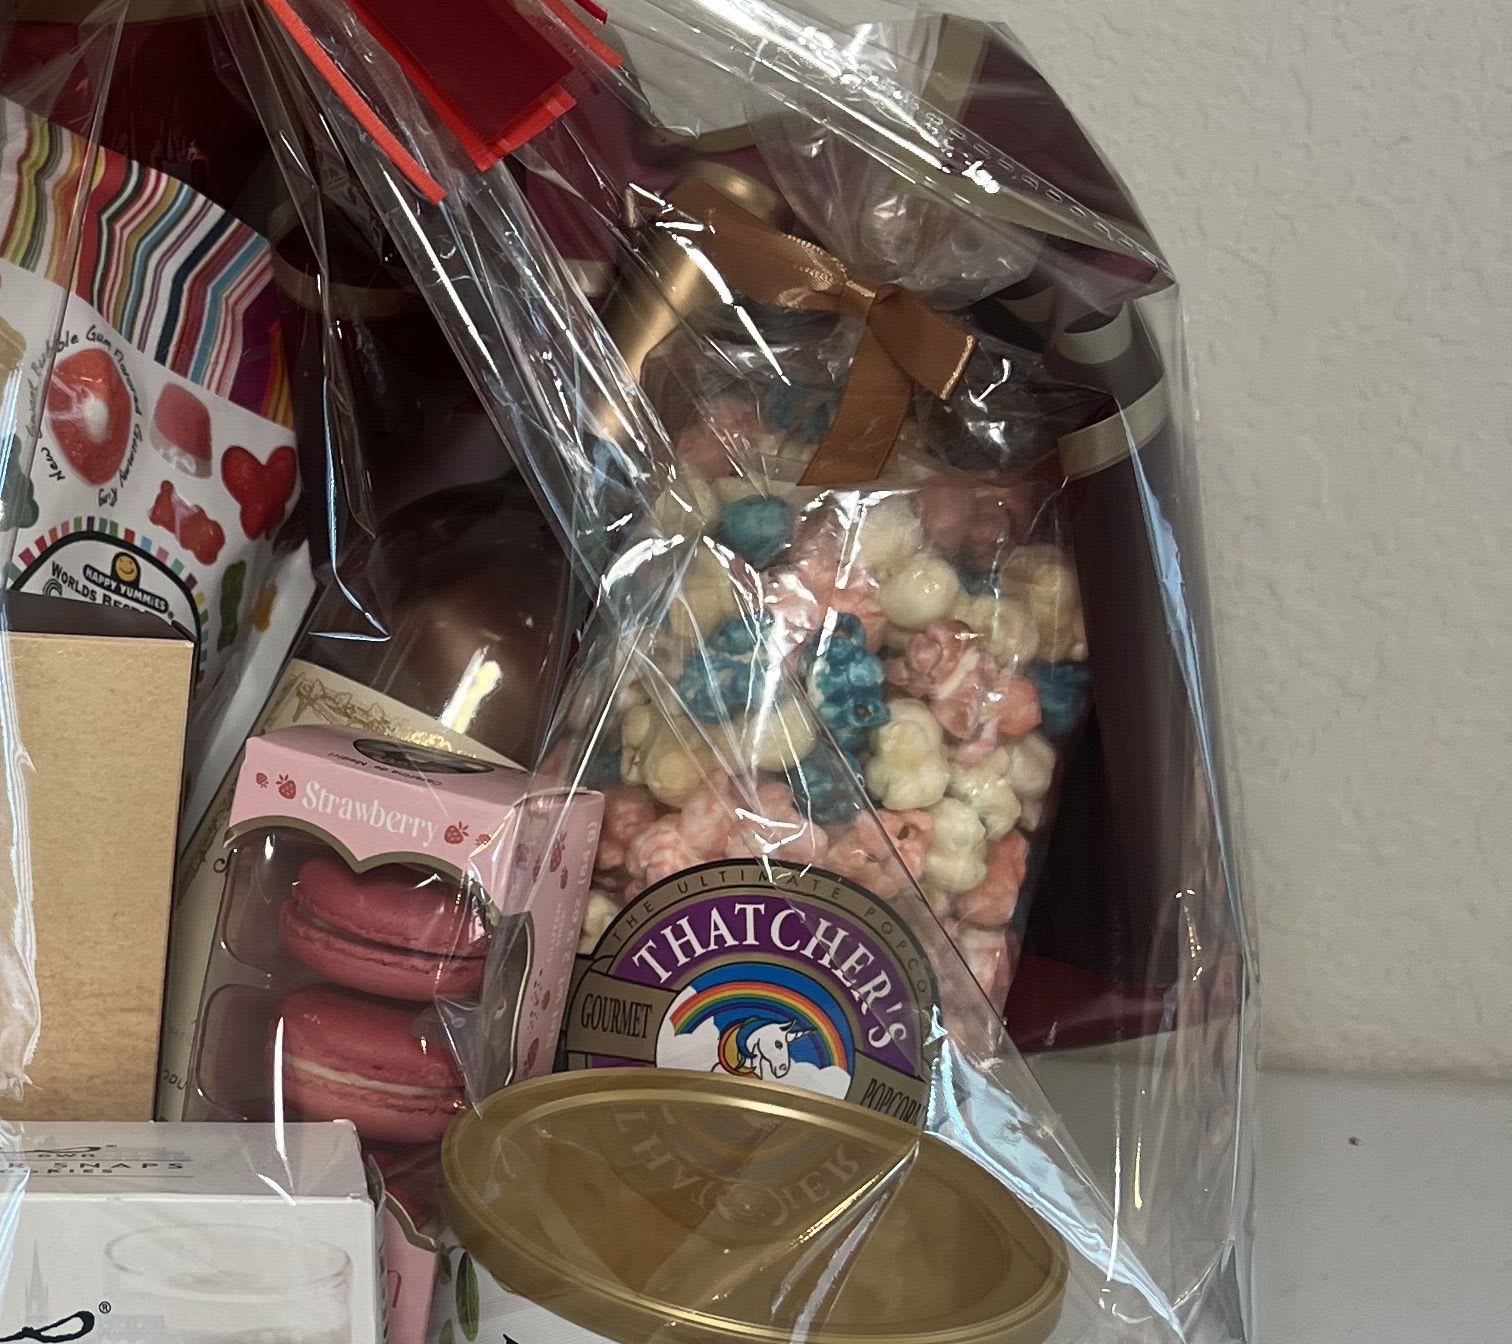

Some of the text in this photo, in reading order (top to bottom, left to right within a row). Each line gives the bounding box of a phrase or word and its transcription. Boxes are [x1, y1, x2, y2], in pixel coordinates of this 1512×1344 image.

[86, 324, 112, 351] Gum
[51, 560, 98, 602] WORLDS
[86, 565, 119, 591] HAPPY
[119, 582, 167, 612] YUMMIES
[302, 780, 439, 848] Strawberry
[613, 902, 655, 943] THE
[677, 869, 842, 902] ULTIMATE
[631, 903, 907, 1049] THATCHER'S
[581, 991, 654, 1040] GOURMET
[53, 1162, 184, 1170] SNAPS
